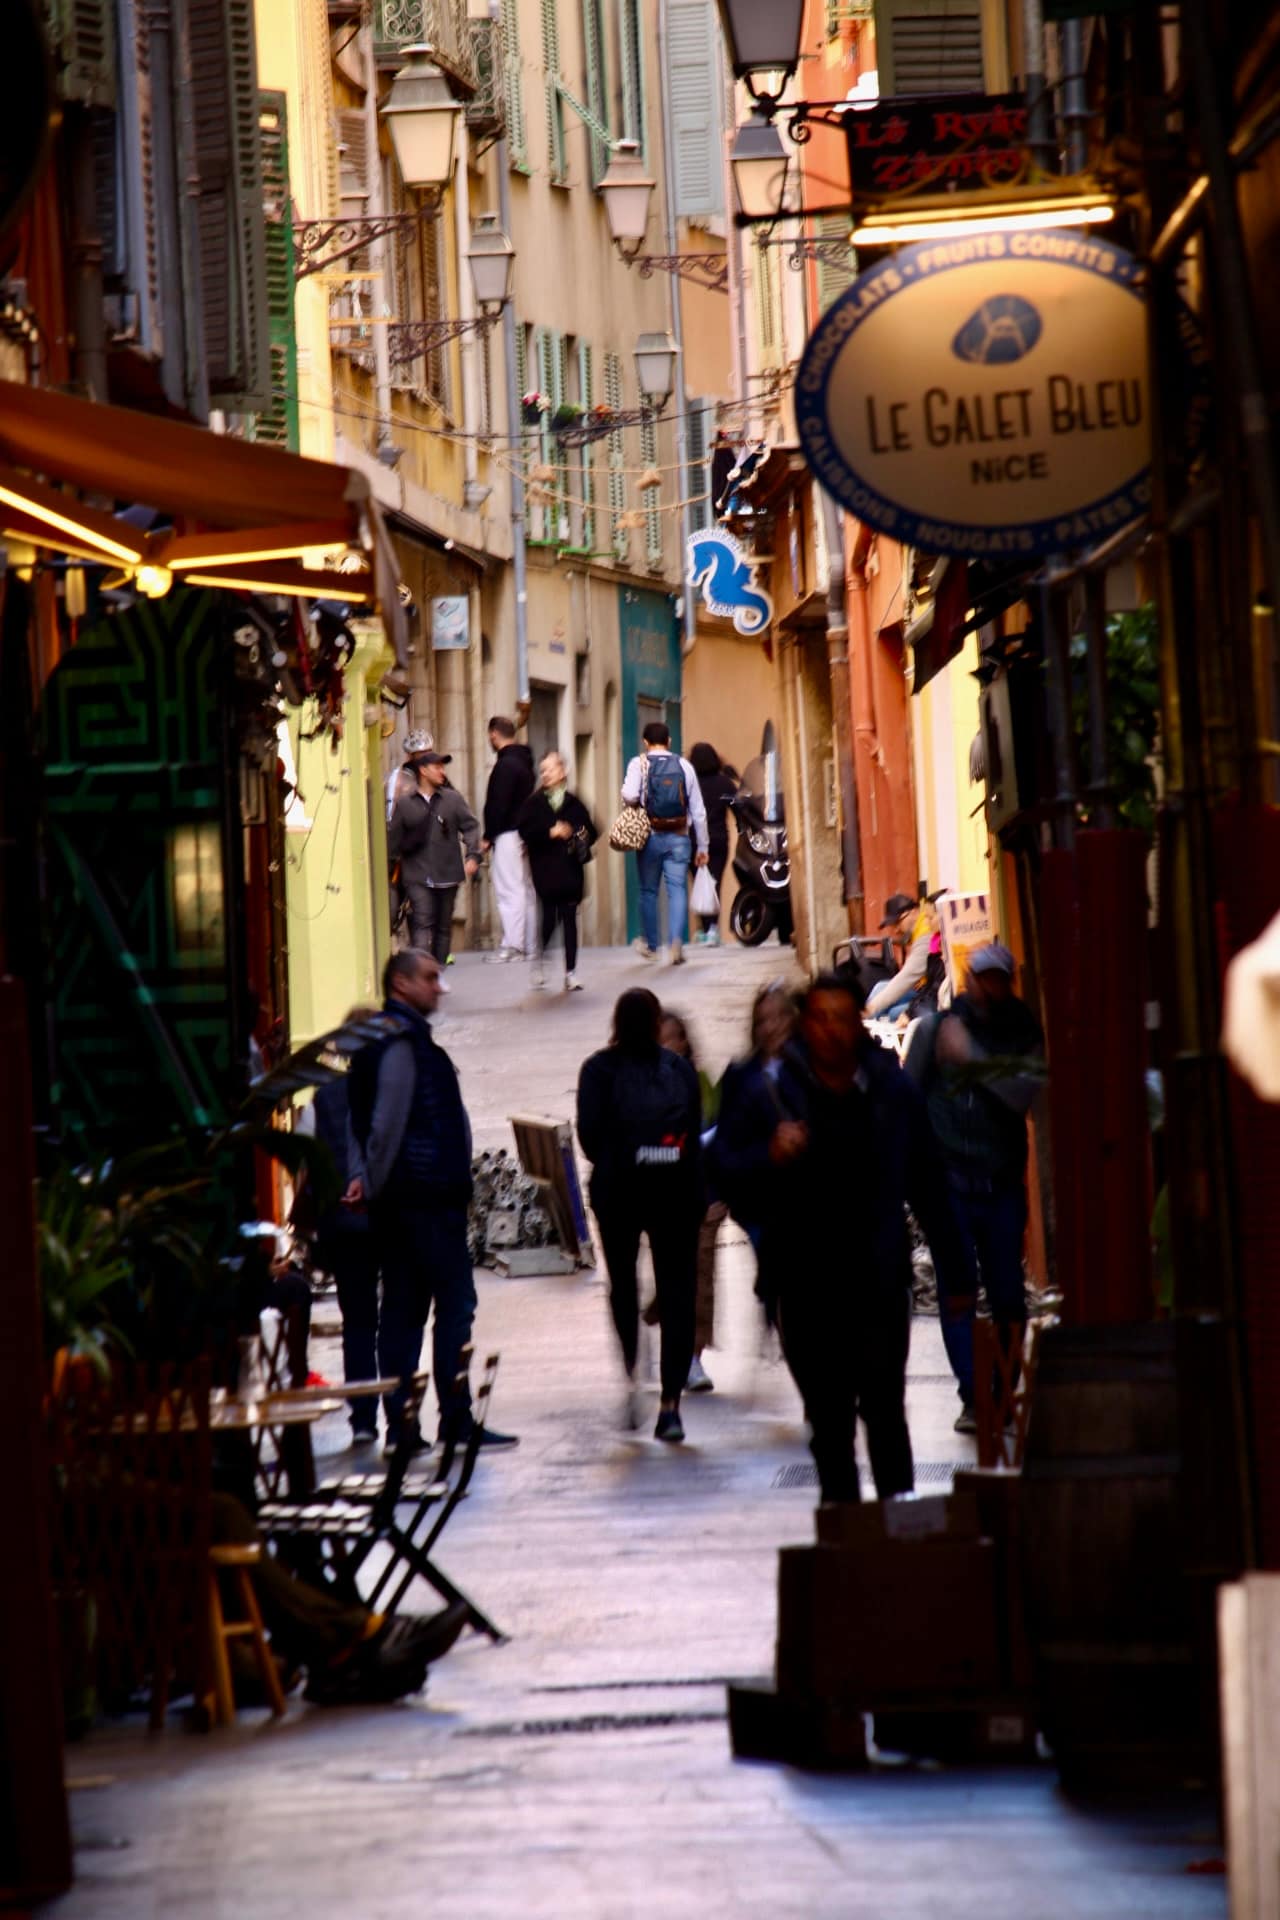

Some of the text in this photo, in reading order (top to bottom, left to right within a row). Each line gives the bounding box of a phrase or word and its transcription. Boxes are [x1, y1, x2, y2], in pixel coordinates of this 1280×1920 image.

[803, 233, 1117, 392] CHOCOLATS FRUITS CONFITS
[865, 393, 913, 454] LE
[924, 386, 1033, 447] GALET
[1048, 373, 1143, 435] BLEU
[803, 416, 897, 528] CALISSONS
[916, 522, 1034, 550] NOUGATS
